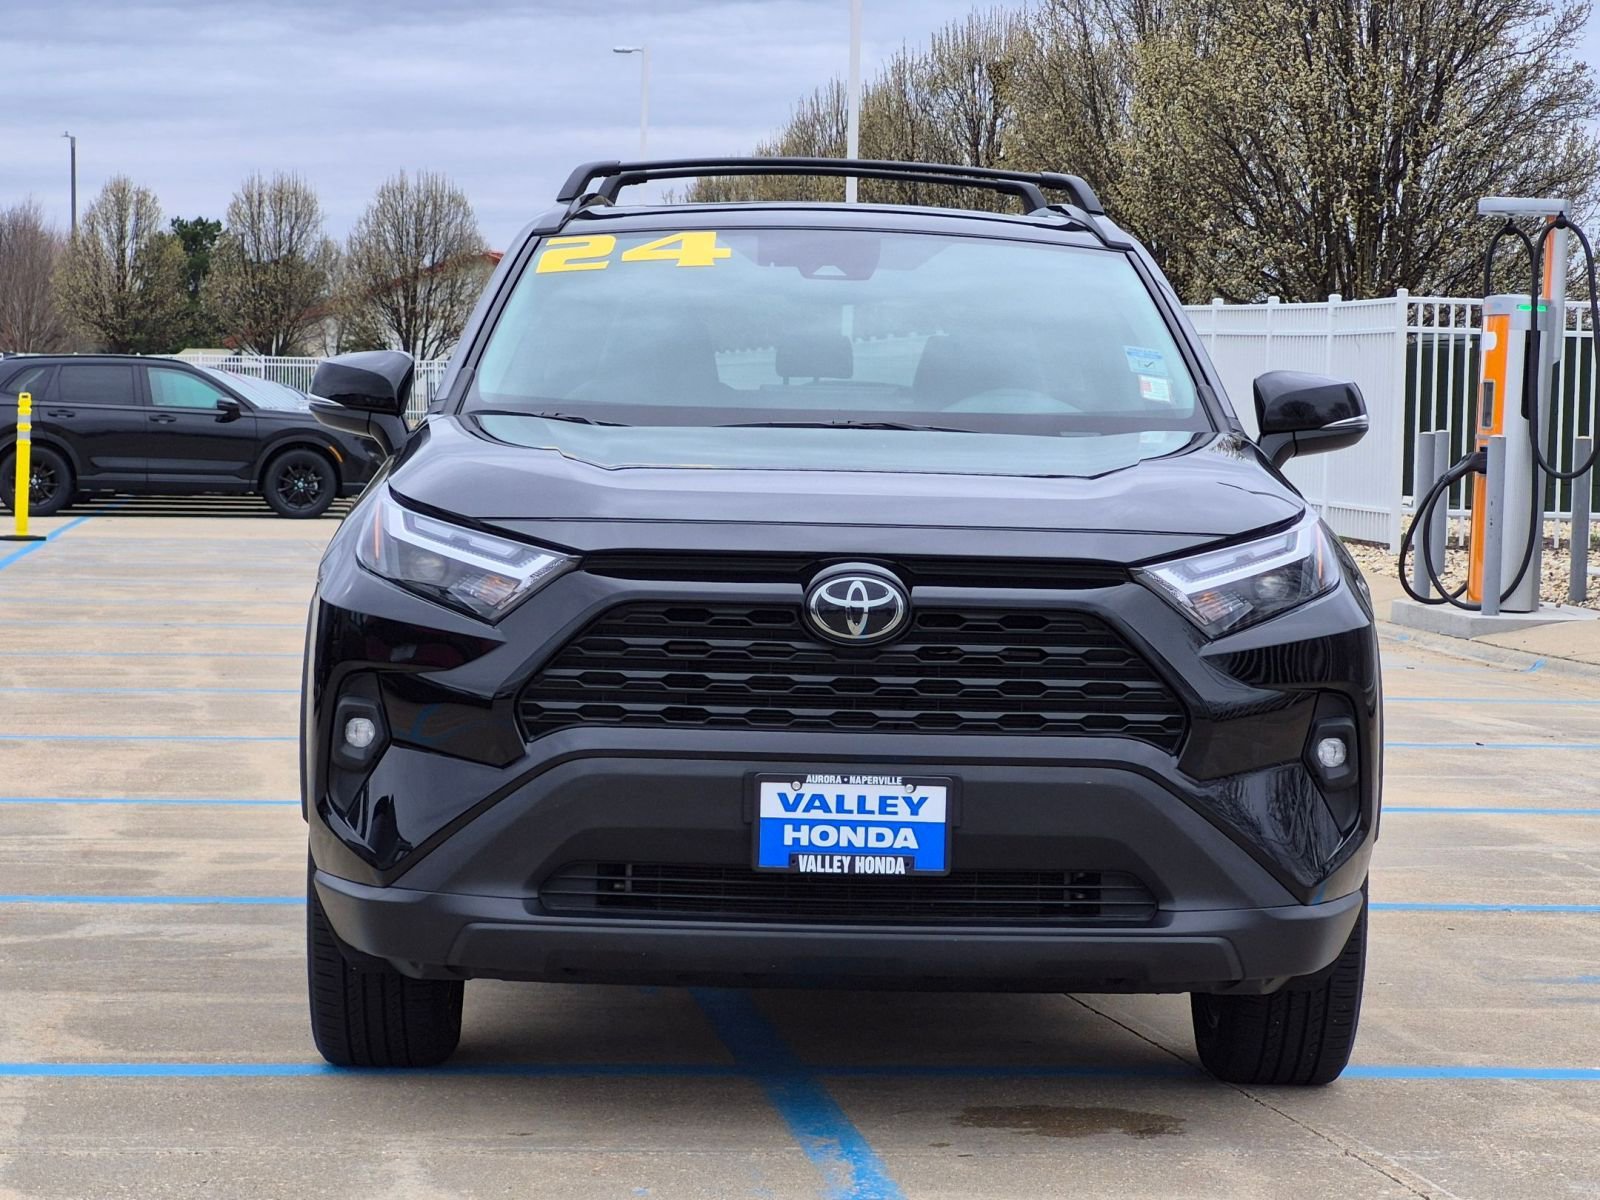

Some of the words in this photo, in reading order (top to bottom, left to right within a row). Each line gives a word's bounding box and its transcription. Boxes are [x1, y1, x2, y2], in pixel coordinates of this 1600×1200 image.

[535, 231, 732, 274] 24
[806, 774, 842, 784] AURORA
[849, 775, 903, 785] NAPERVILLE
[777, 792, 929, 816] VALLEY
[783, 824, 919, 850] HONDA
[798, 854, 851, 873] VALLEY
[855, 856, 906, 875] HONDA
